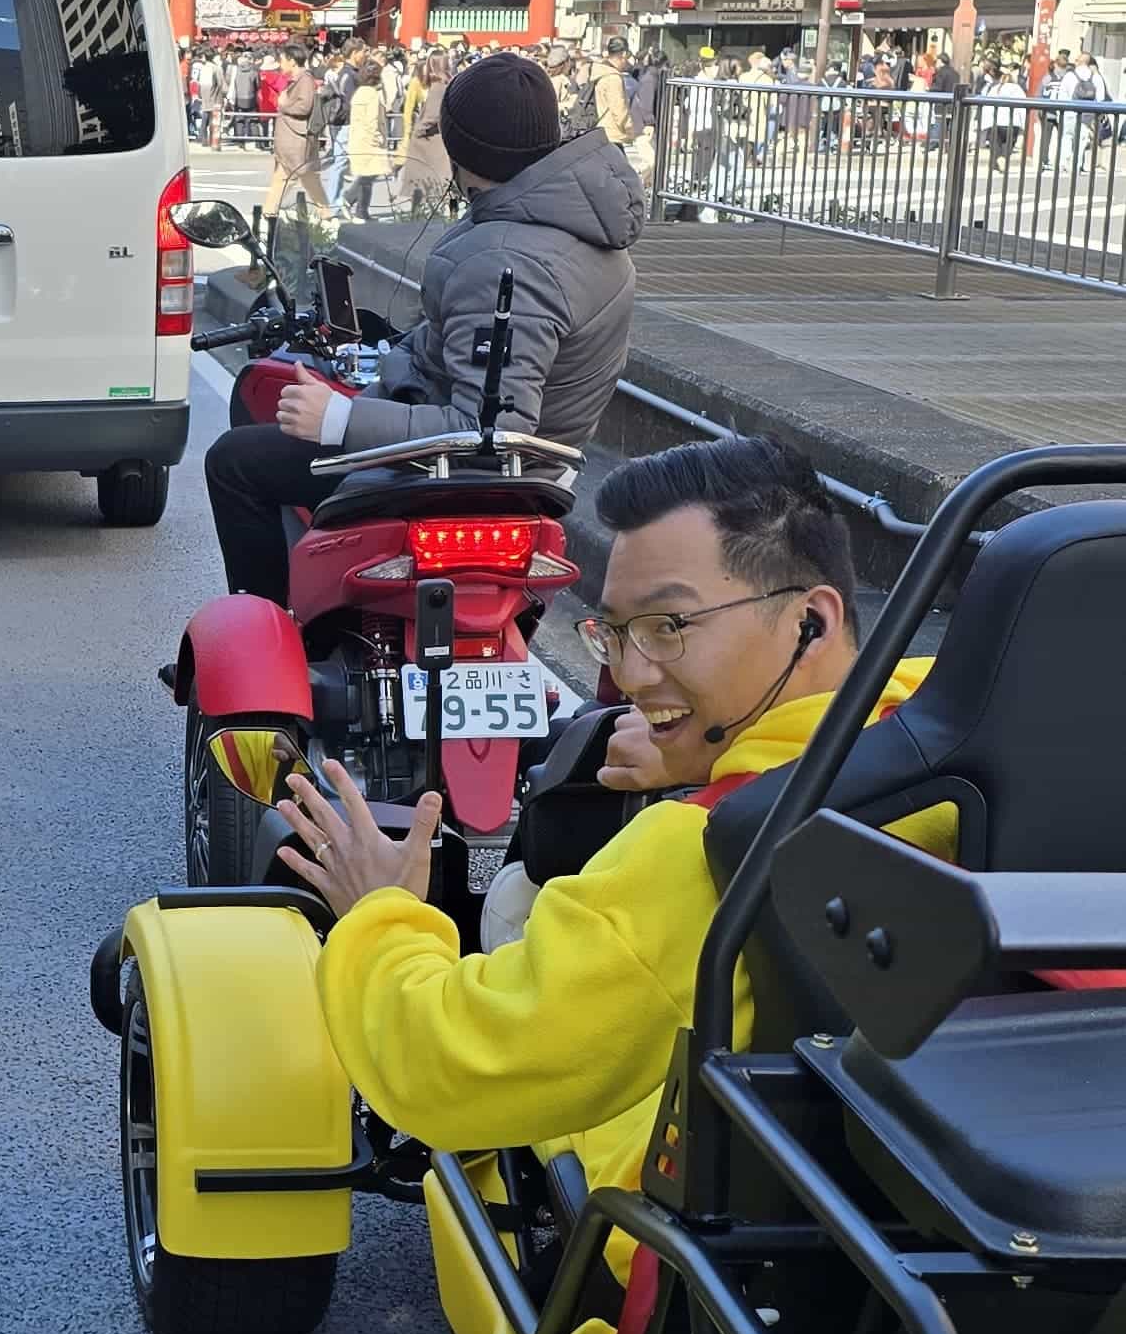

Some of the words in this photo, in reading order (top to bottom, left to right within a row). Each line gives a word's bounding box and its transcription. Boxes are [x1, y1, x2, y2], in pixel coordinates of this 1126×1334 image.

[446, 672, 460, 690] 2
[465, 670, 502, 690] 品川
[518, 669, 531, 689] さ
